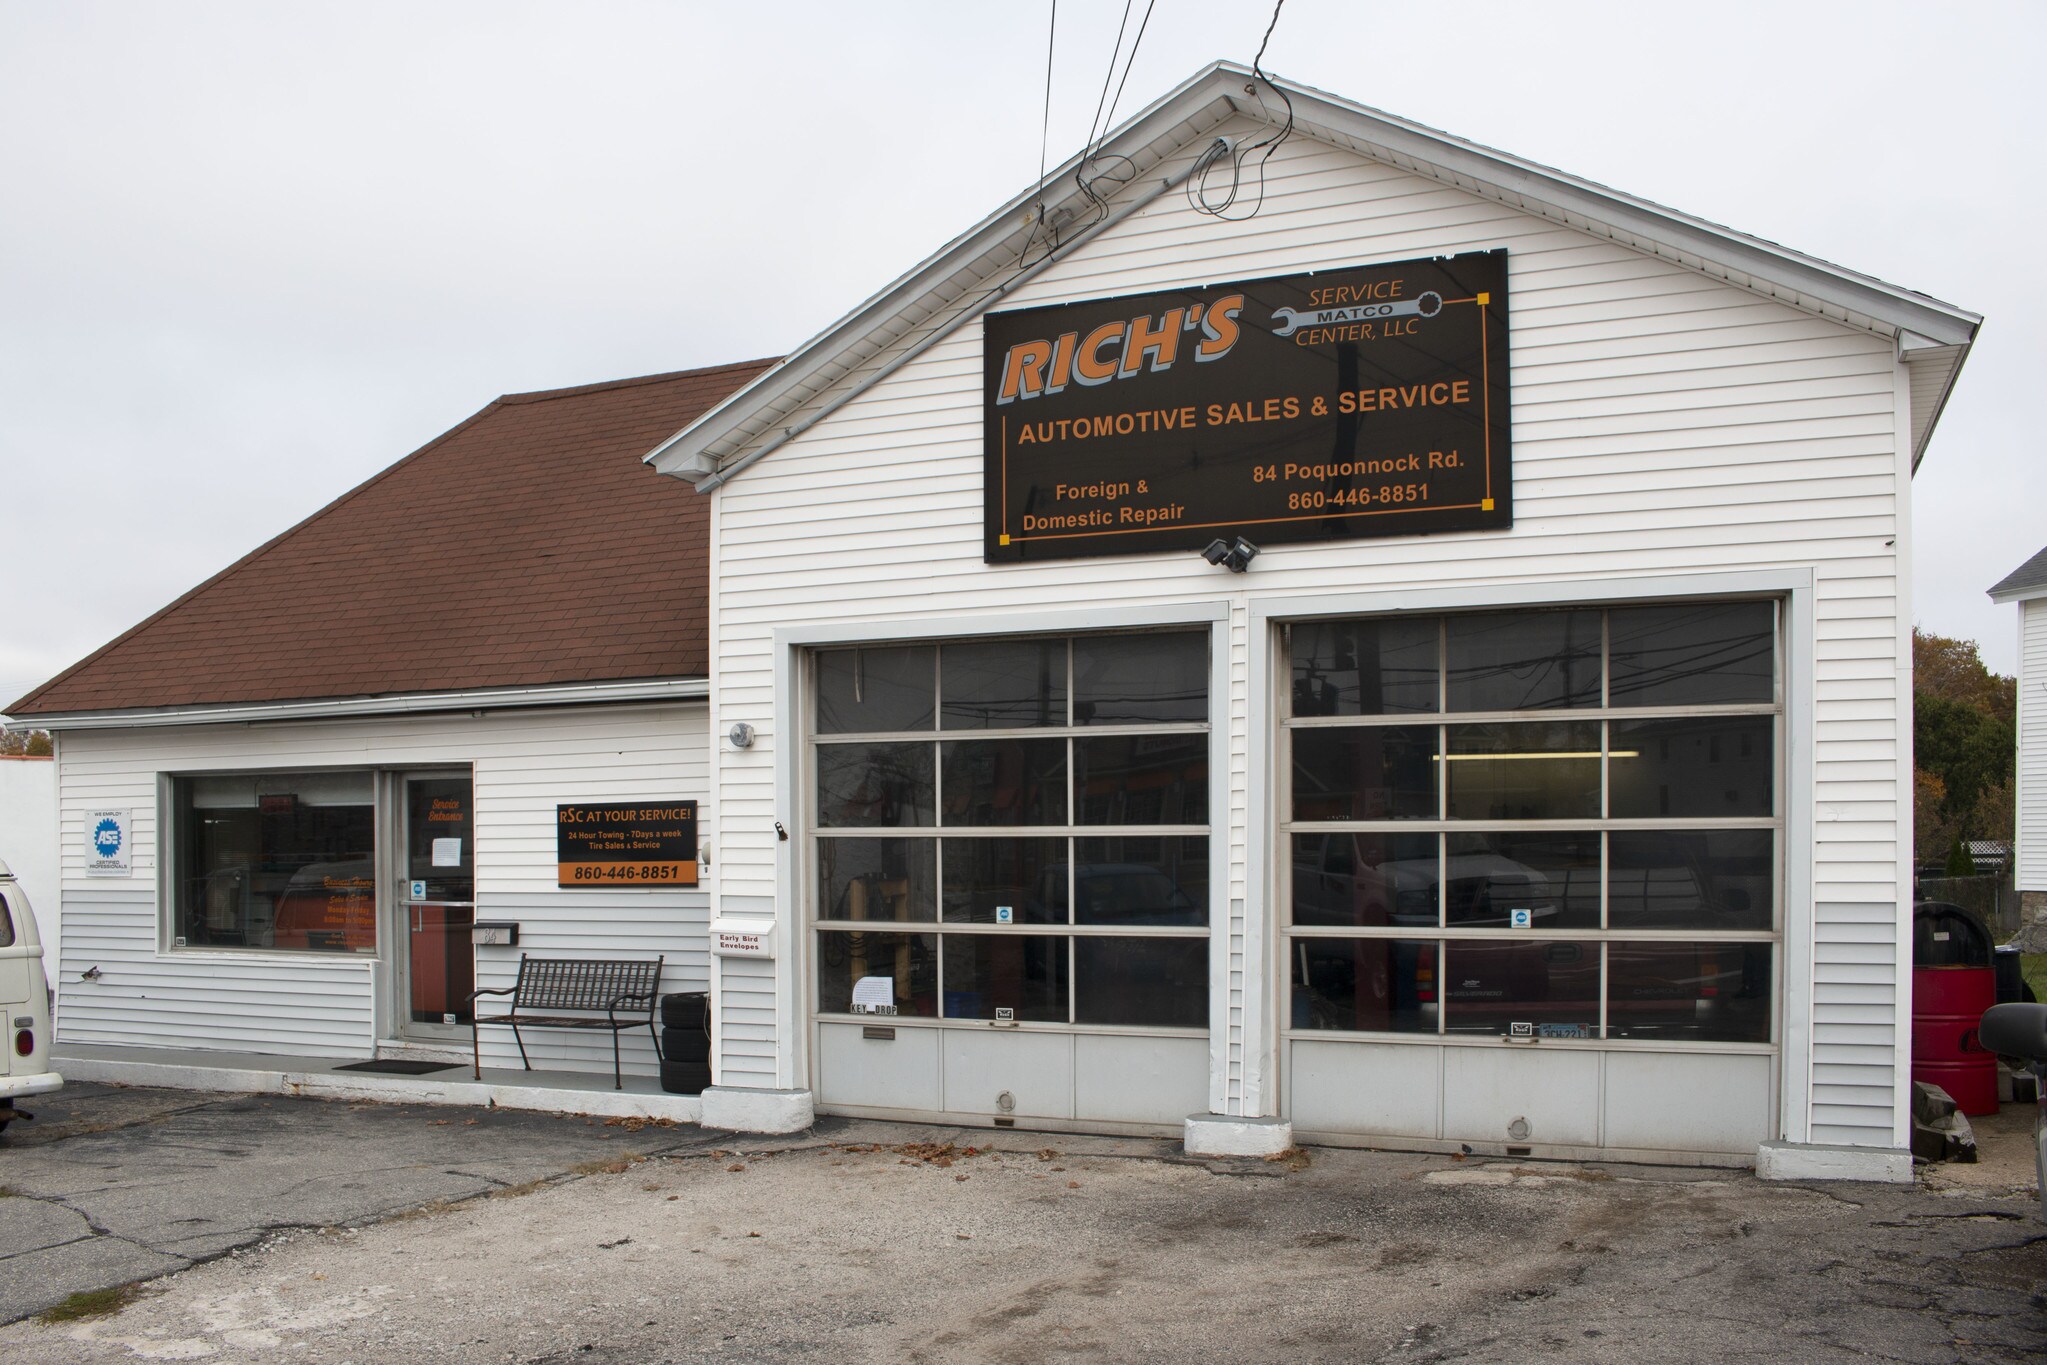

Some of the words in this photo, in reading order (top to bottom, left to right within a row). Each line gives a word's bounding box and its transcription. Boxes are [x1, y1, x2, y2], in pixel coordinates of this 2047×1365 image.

[1309, 280, 1403, 306] SERVICE
[1317, 305, 1393, 323] MATCO
[1296, 323, 1376, 346] CENTER,
[1384, 318, 1419, 337] LLC
[996, 295, 1244, 405] RICH'S
[1018, 406, 1196, 445] AUTOMOTIVE
[1206, 397, 1300, 426] SALES
[1311, 396, 1328, 417] &
[1339, 380, 1470, 414] SERVICE
[1253, 466, 1277, 483] 84
[1284, 454, 1420, 481] Poquonnock
[1428, 450, 1465, 469] Rd.
[1056, 480, 1129, 501] Foreign
[1136, 479, 1149, 494] &
[1288, 483, 1428, 510] 860-446-8851
[1023, 509, 1113, 531] Domestic
[1119, 503, 1185, 525] Repair
[432, 799, 459, 809] Service
[428, 811, 464, 822] Entrance
[586, 811, 602, 822] AT
[604, 810, 636, 822] YOUR
[640, 808, 691, 821] SERVICE!
[97, 830, 119, 845] ASE
[568, 832, 577, 840] 24
[579, 831, 596, 840] Hour
[598, 831, 625, 840] Towing
[589, 842, 602, 850] Tire
[604, 841, 625, 850] Sales
[633, 841, 661, 849] Service
[575, 866, 679, 880] 860-446-8851
[719, 934, 739, 942] Early
[720, 942, 759, 950] Envelopes
[851, 1004, 867, 1013] KEY
[875, 1005, 897, 1015] DROP
